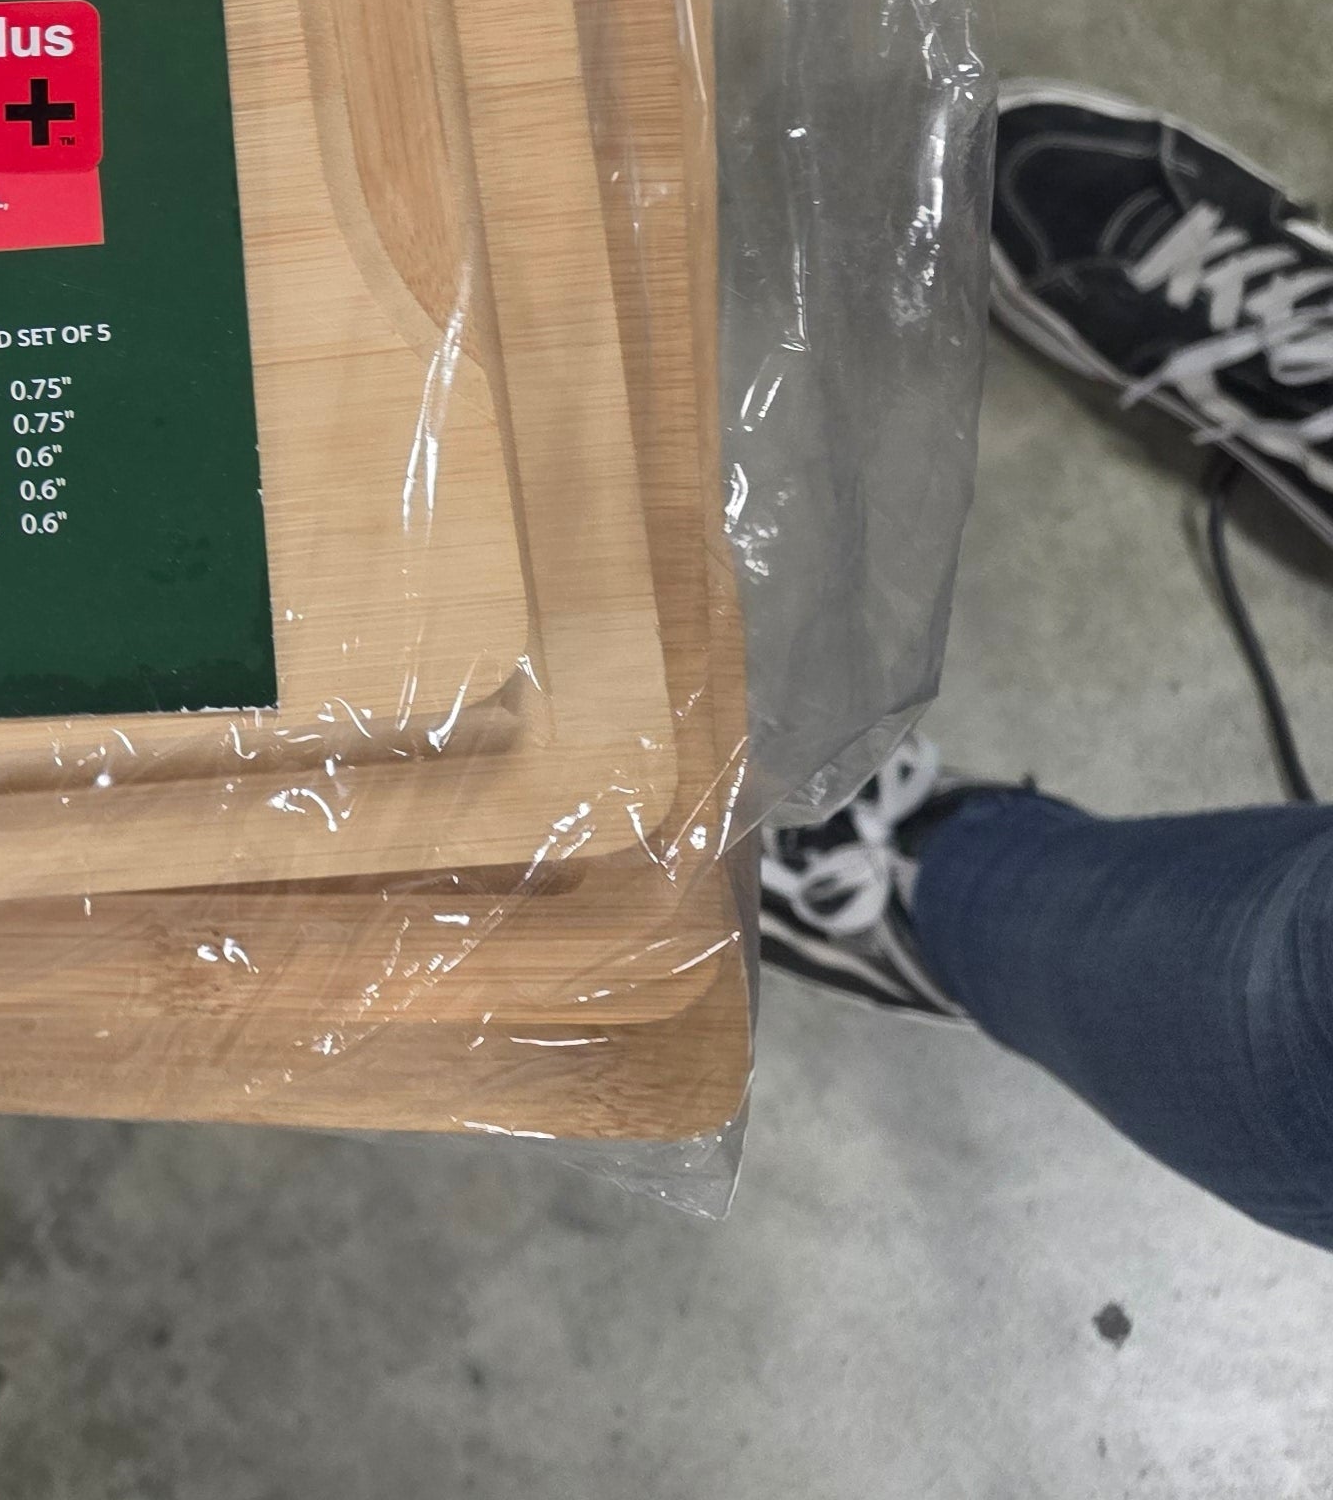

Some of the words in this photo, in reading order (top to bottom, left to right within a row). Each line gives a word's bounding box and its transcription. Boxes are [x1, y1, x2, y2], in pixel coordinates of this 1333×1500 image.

[17, 327, 56, 347] SET
[62, 325, 93, 344] OF
[97, 324, 111, 342] 5
[11, 376, 71, 400] 0.75"
[13, 410, 74, 434] 0.75"
[16, 445, 62, 468] 0.6"
[20, 478, 66, 501] 0.6"
[21, 511, 67, 534] 0.6"
